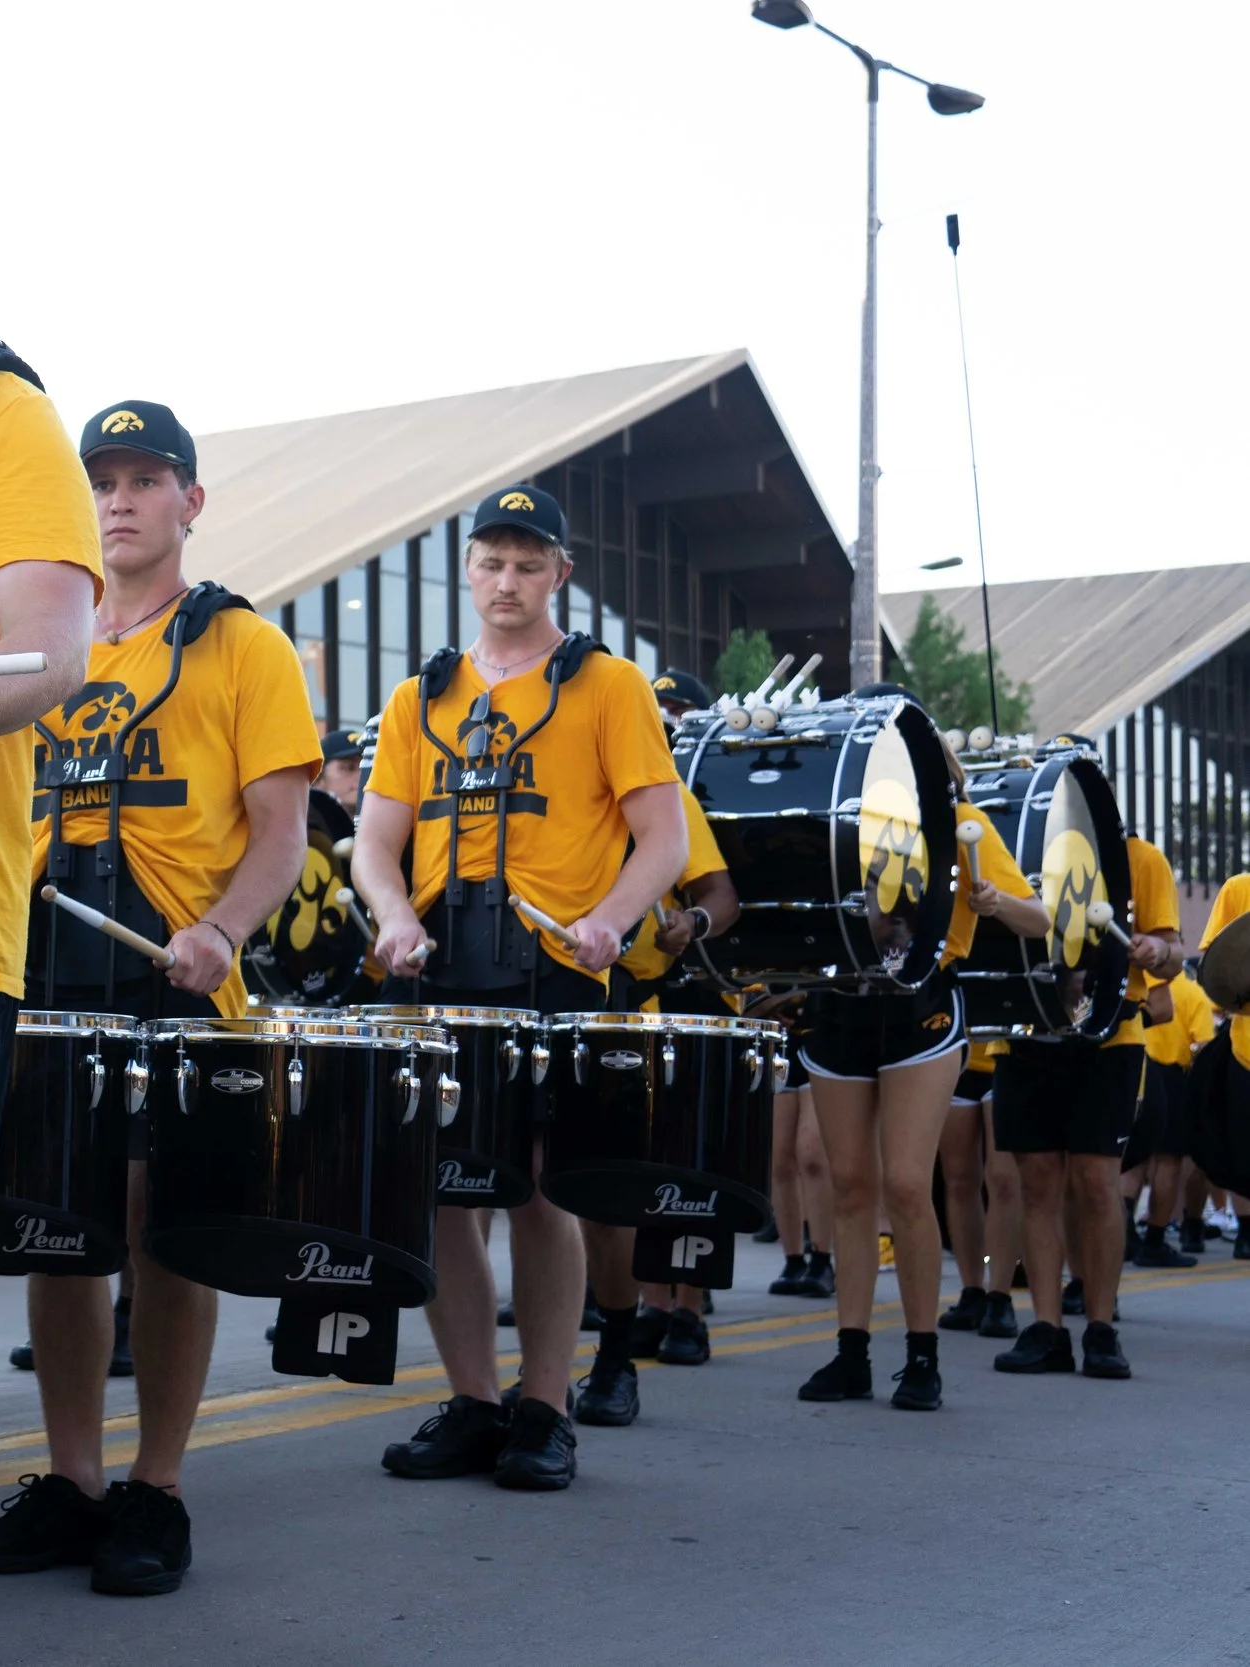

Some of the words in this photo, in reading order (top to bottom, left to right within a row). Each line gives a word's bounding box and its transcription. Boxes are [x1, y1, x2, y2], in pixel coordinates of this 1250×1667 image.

[62, 784, 110, 807] BAND
[459, 796, 495, 812] AND
[438, 1160, 496, 1192] Pearl
[645, 1183, 718, 1216] Pearl
[2, 1214, 85, 1256] Pearl
[285, 1242, 374, 1285] Pearl
